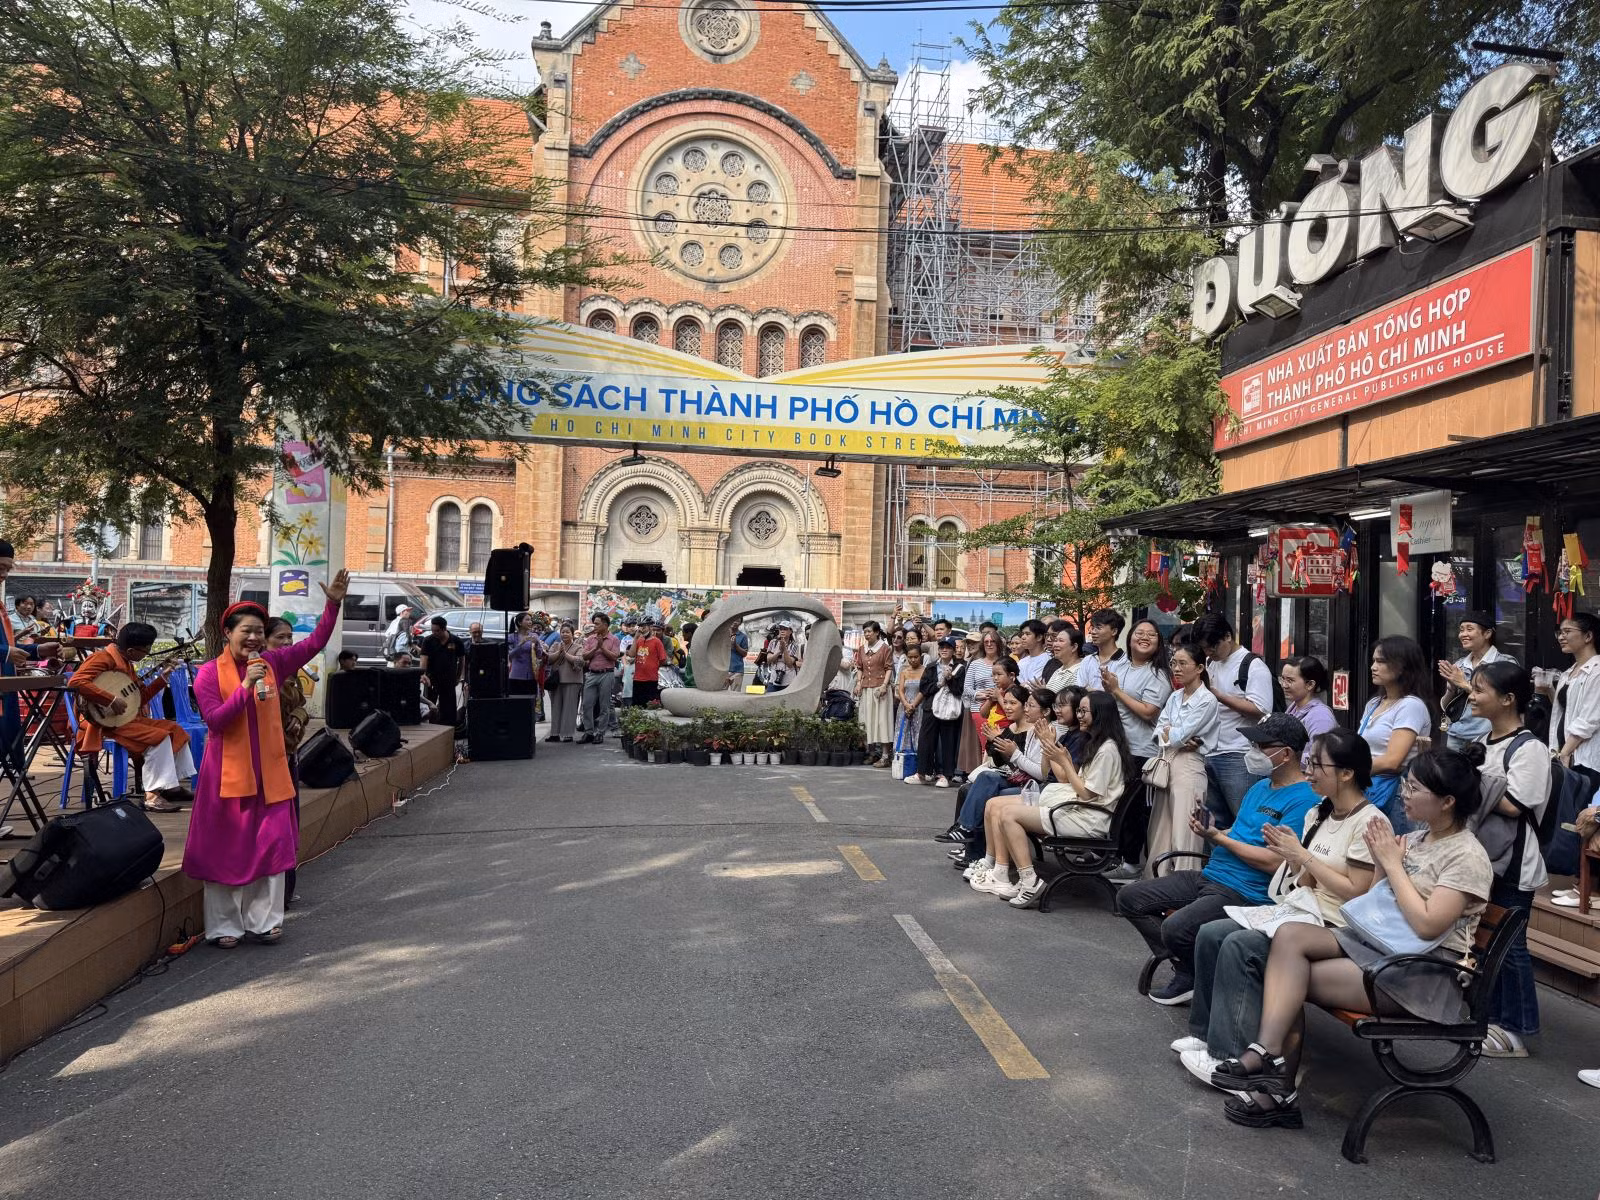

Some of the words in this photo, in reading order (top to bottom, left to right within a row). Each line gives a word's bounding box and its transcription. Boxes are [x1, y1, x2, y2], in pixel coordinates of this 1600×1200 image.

[1190, 63, 1553, 343] ĐƯỜNG
[1266, 379, 1312, 409] THÀNH
[1315, 361, 1346, 393] PHỐ
[1378, 339, 1408, 370] CHÍ
[1413, 319, 1467, 359] MINH
[1267, 357, 1294, 385] NHÀ
[1298, 342, 1334, 375] XUẤT
[1337, 328, 1369, 359] BẢN
[1373, 306, 1422, 343] TỔNG
[1428, 287, 1471, 323] HỢP
[552, 376, 647, 412] SÁCH
[658, 384, 778, 420] THÀNH
[789, 393, 860, 424] PHỐ
[869, 396, 918, 427] HỒ
[928, 400, 985, 430] CHÍ
[1256, 415, 1279, 430] MINH
[1283, 407, 1305, 422] CITY
[1310, 392, 1357, 414] GENERAL
[1364, 362, 1444, 397] PUBLISHING
[1453, 341, 1505, 369] HOUSE
[550, 418, 575, 433] HO
[595, 420, 632, 436] CHI
[652, 424, 706, 440] MINH
[726, 428, 775, 444] CITY
[794, 432, 847, 447] BOOK
[1313, 843, 1332, 857] think
